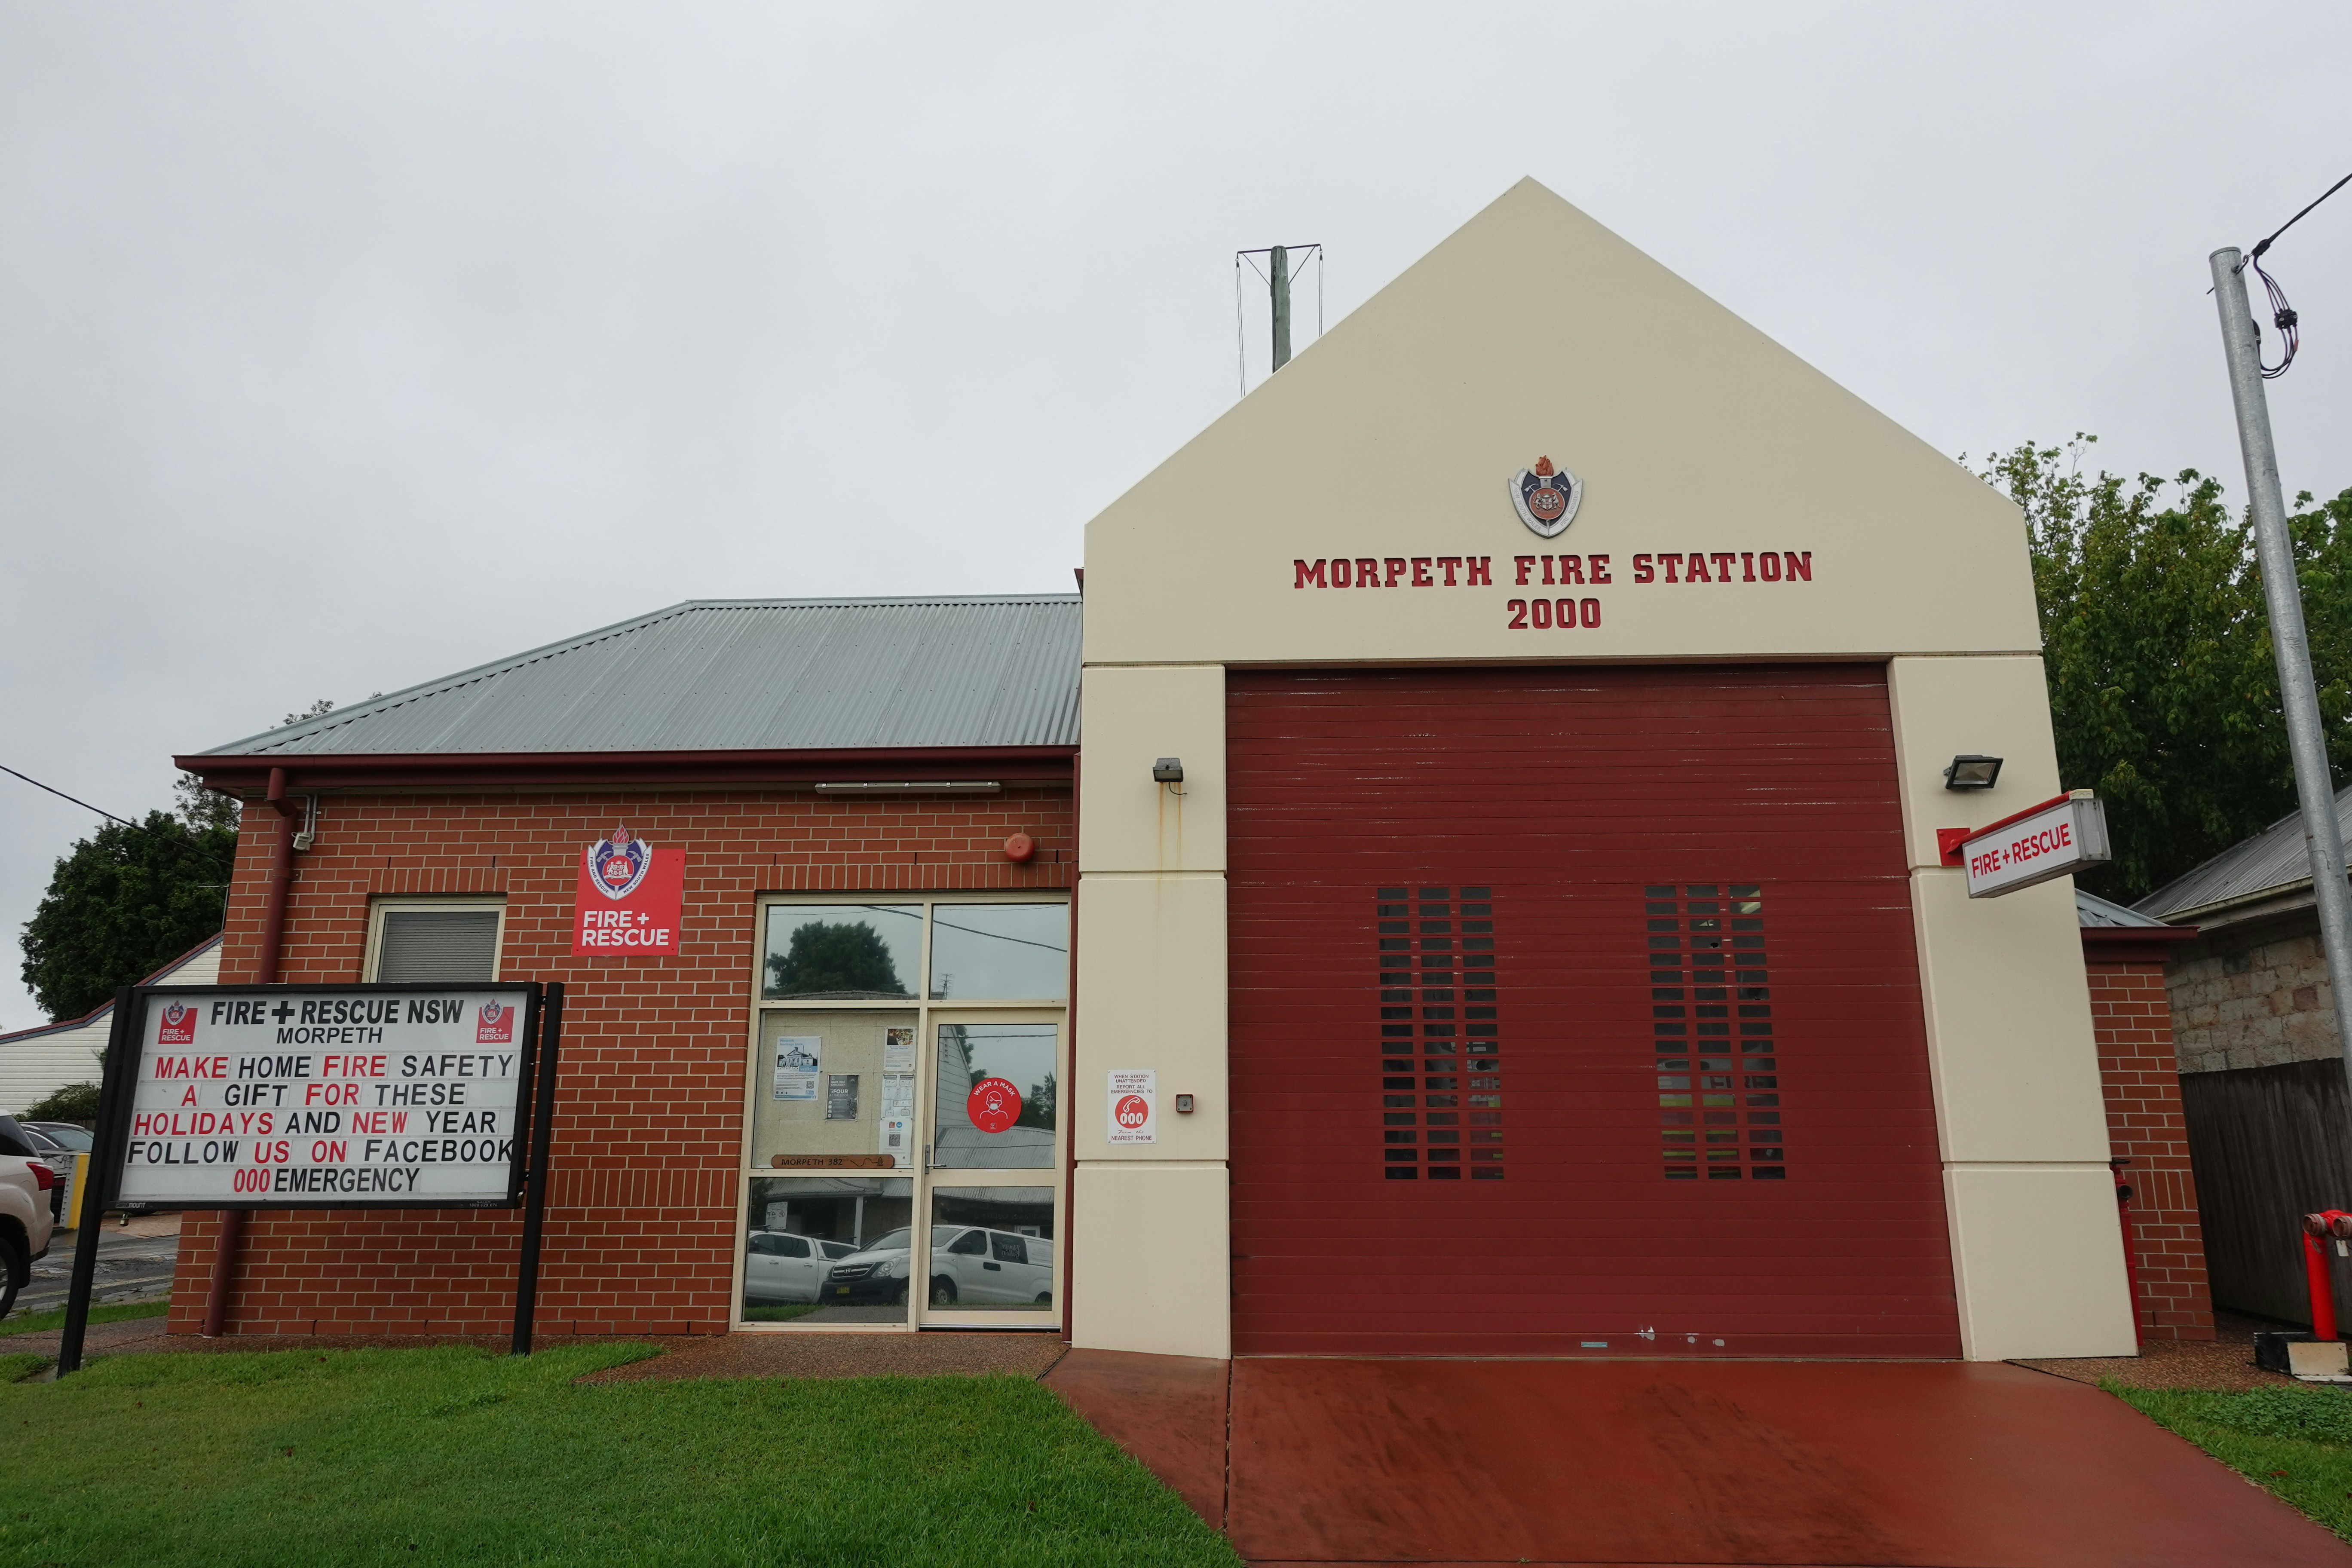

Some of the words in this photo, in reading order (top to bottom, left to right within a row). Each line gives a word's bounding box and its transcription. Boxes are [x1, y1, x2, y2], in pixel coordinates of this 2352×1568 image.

[1517, 500, 1527, 516] SOUTH
[1527, 517, 1541, 531] WALES
[1560, 516, 1570, 527] FIRE
[1568, 490, 1579, 514] BRIGADES
[1294, 556, 1492, 589] MORPETH
[1514, 554, 1611, 585] FIRE
[1632, 551, 1812, 583] STATION
[1507, 598, 1601, 629] 2000
[1971, 849, 2001, 879] FIRE
[2012, 823, 2071, 864] RESCUE
[595, 879, 609, 894] RESCUE
[623, 885, 633, 894] NEW
[633, 870, 644, 886] SOUTH
[583, 910, 633, 927] FIRE
[582, 929, 670, 946] RESCUE
[211, 1001, 266, 1025] FIRE
[300, 1000, 400, 1024] RESCUE
[407, 999, 465, 1024] NSW
[276, 1027, 383, 1044] MORPETH
[155, 1057, 229, 1078] MAKE
[239, 1056, 311, 1079] HOME
[323, 1055, 387, 1077] FIRE
[401, 1054, 513, 1077] SAFETY
[181, 1085, 197, 1106] A
[225, 1084, 288, 1106] GIFT
[305, 1084, 359, 1106] FOR
[375, 1083, 466, 1106] THESE
[974, 1081, 992, 1096] WEAR
[999, 1082, 1016, 1096] MASK
[133, 1112, 273, 1136] HOLIDAYS
[285, 1112, 340, 1134] AND
[352, 1112, 408, 1133] NEW
[426, 1111, 496, 1133] YEAR
[1120, 1112, 1143, 1124] 000
[128, 1140, 239, 1164] FOLLOW
[254, 1140, 289, 1164] US
[311, 1140, 347, 1163] ON
[364, 1139, 514, 1163] FACEBOOK
[233, 1168, 270, 1193] 000
[274, 1168, 420, 1192] EMERGENCY
